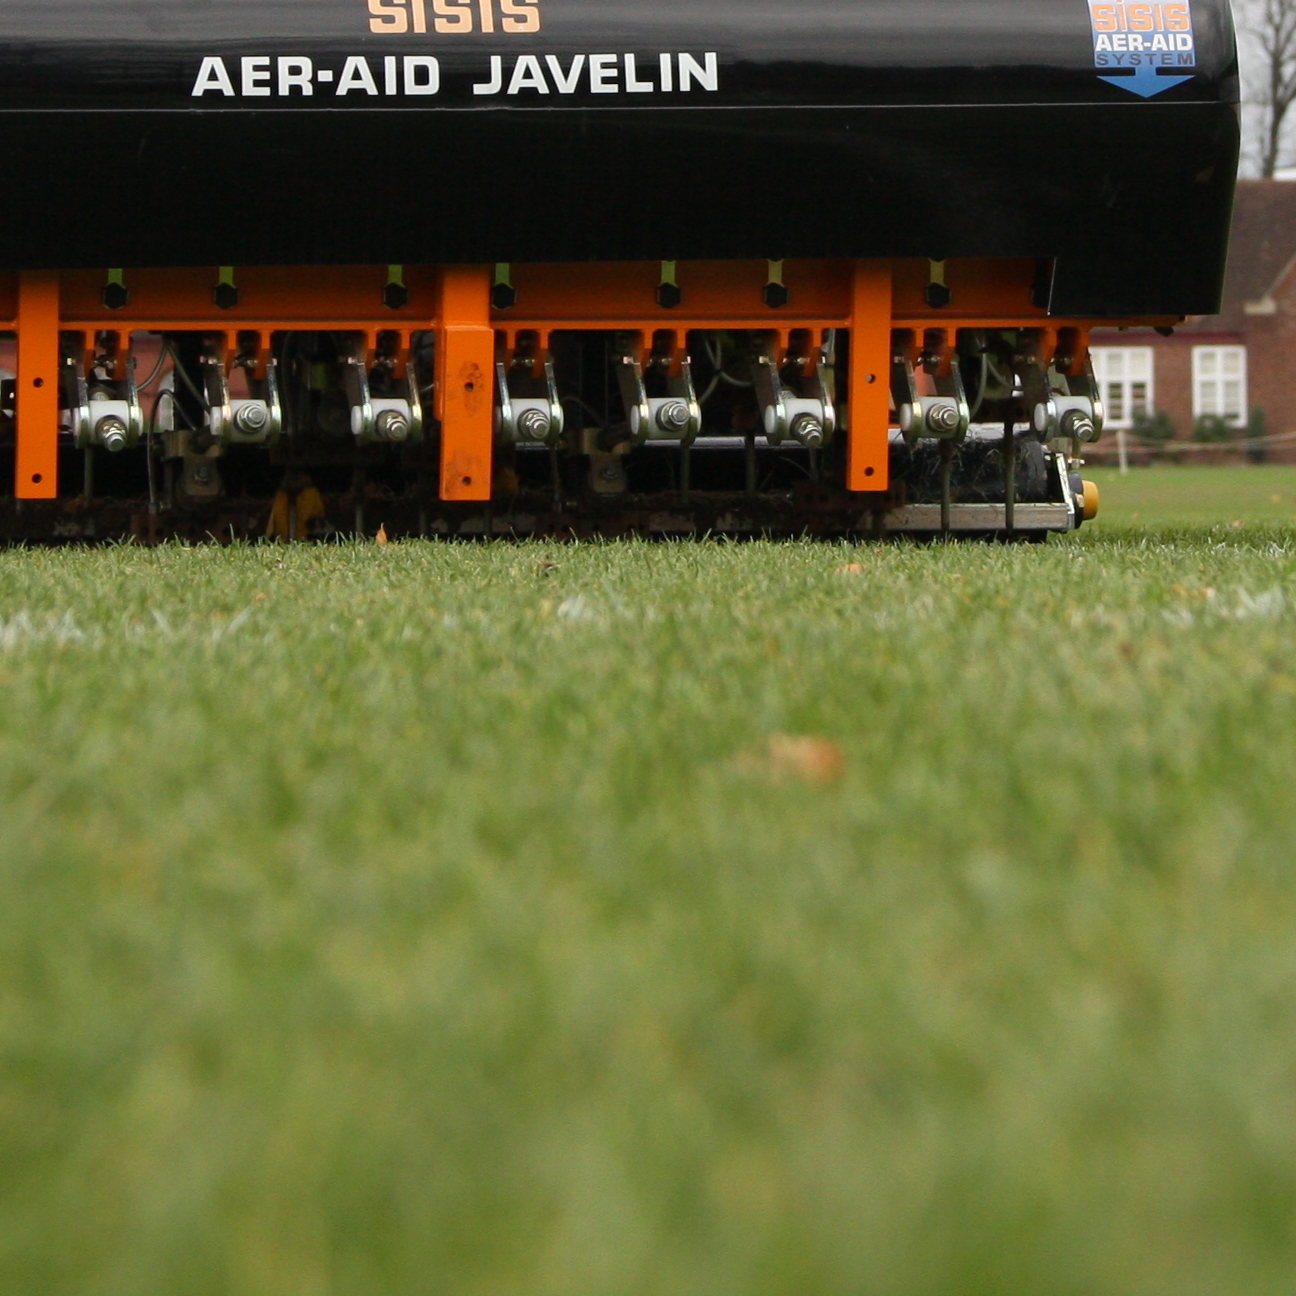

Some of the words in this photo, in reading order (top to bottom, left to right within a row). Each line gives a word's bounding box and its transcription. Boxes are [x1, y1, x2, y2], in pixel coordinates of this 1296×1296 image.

[1095, 34, 1193, 51] AER-AID
[1096, 53, 1193, 66] SYSTEM
[191, 55, 440, 97] AER-AID
[472, 51, 718, 96] JAVELIN
